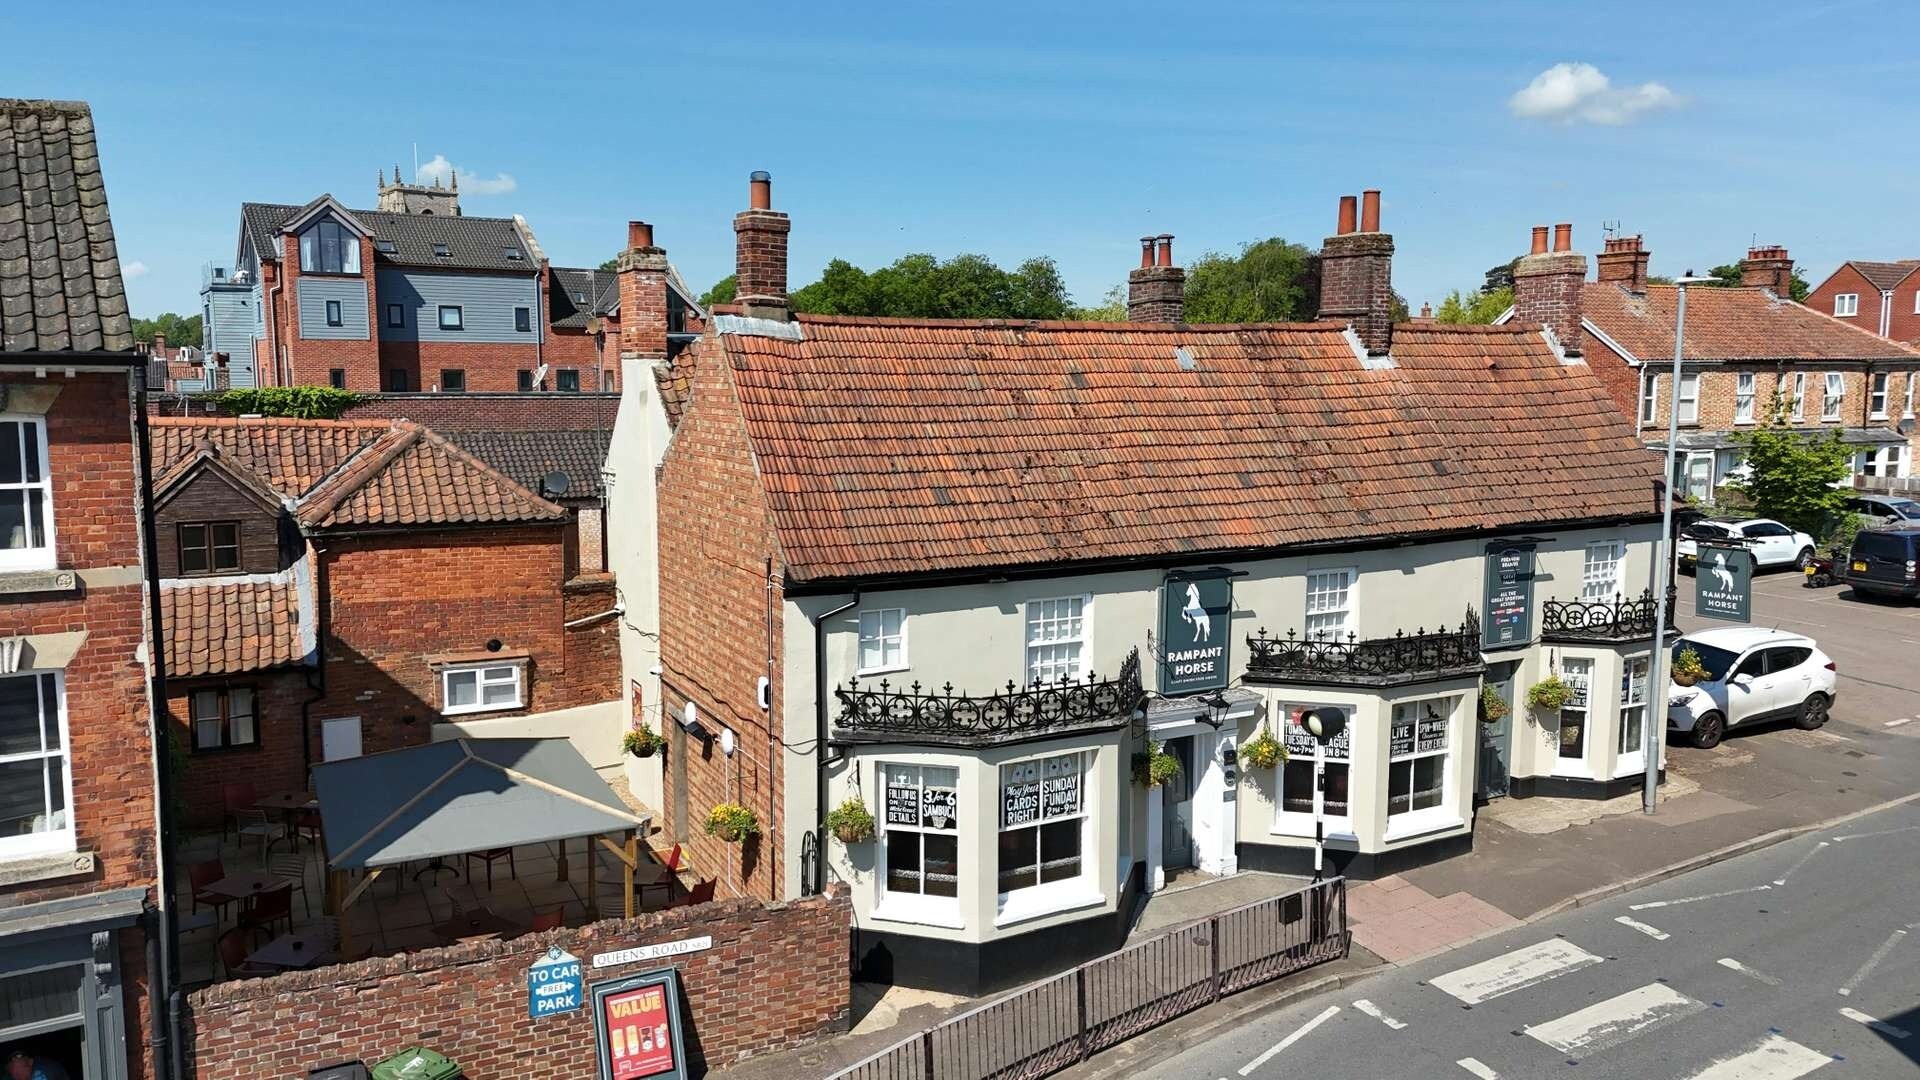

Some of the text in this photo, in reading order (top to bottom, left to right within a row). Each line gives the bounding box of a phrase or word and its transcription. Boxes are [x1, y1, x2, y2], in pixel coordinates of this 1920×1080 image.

[1702, 590, 1743, 602] RAMPANT
[1708, 600, 1737, 610] HORSE
[1167, 647, 1223, 662] RAMPANT
[1175, 661, 1214, 675] HORSE
[1285, 734, 1315, 746] TUESDAYS
[1324, 745, 1334, 756] UN
[1006, 786, 1022, 798] Play
[1043, 776, 1077, 794] SUNDAY
[888, 789, 916, 800] FOLLOW US
[923, 790, 933, 804] 3
[932, 790, 945, 804] for
[1043, 789, 1077, 807] FUNDAY
[1006, 795, 1038, 811] CARDS
[888, 812, 916, 823] DETAILS
[923, 804, 956, 821] SAMBUCA
[597, 948, 646, 965] QUEENS
[651, 942, 688, 957] ROAD
[529, 965, 580, 983] TO CAR
[543, 984, 564, 994] FREE
[537, 994, 575, 1012] PARK
[610, 996, 662, 1019] VALUE
